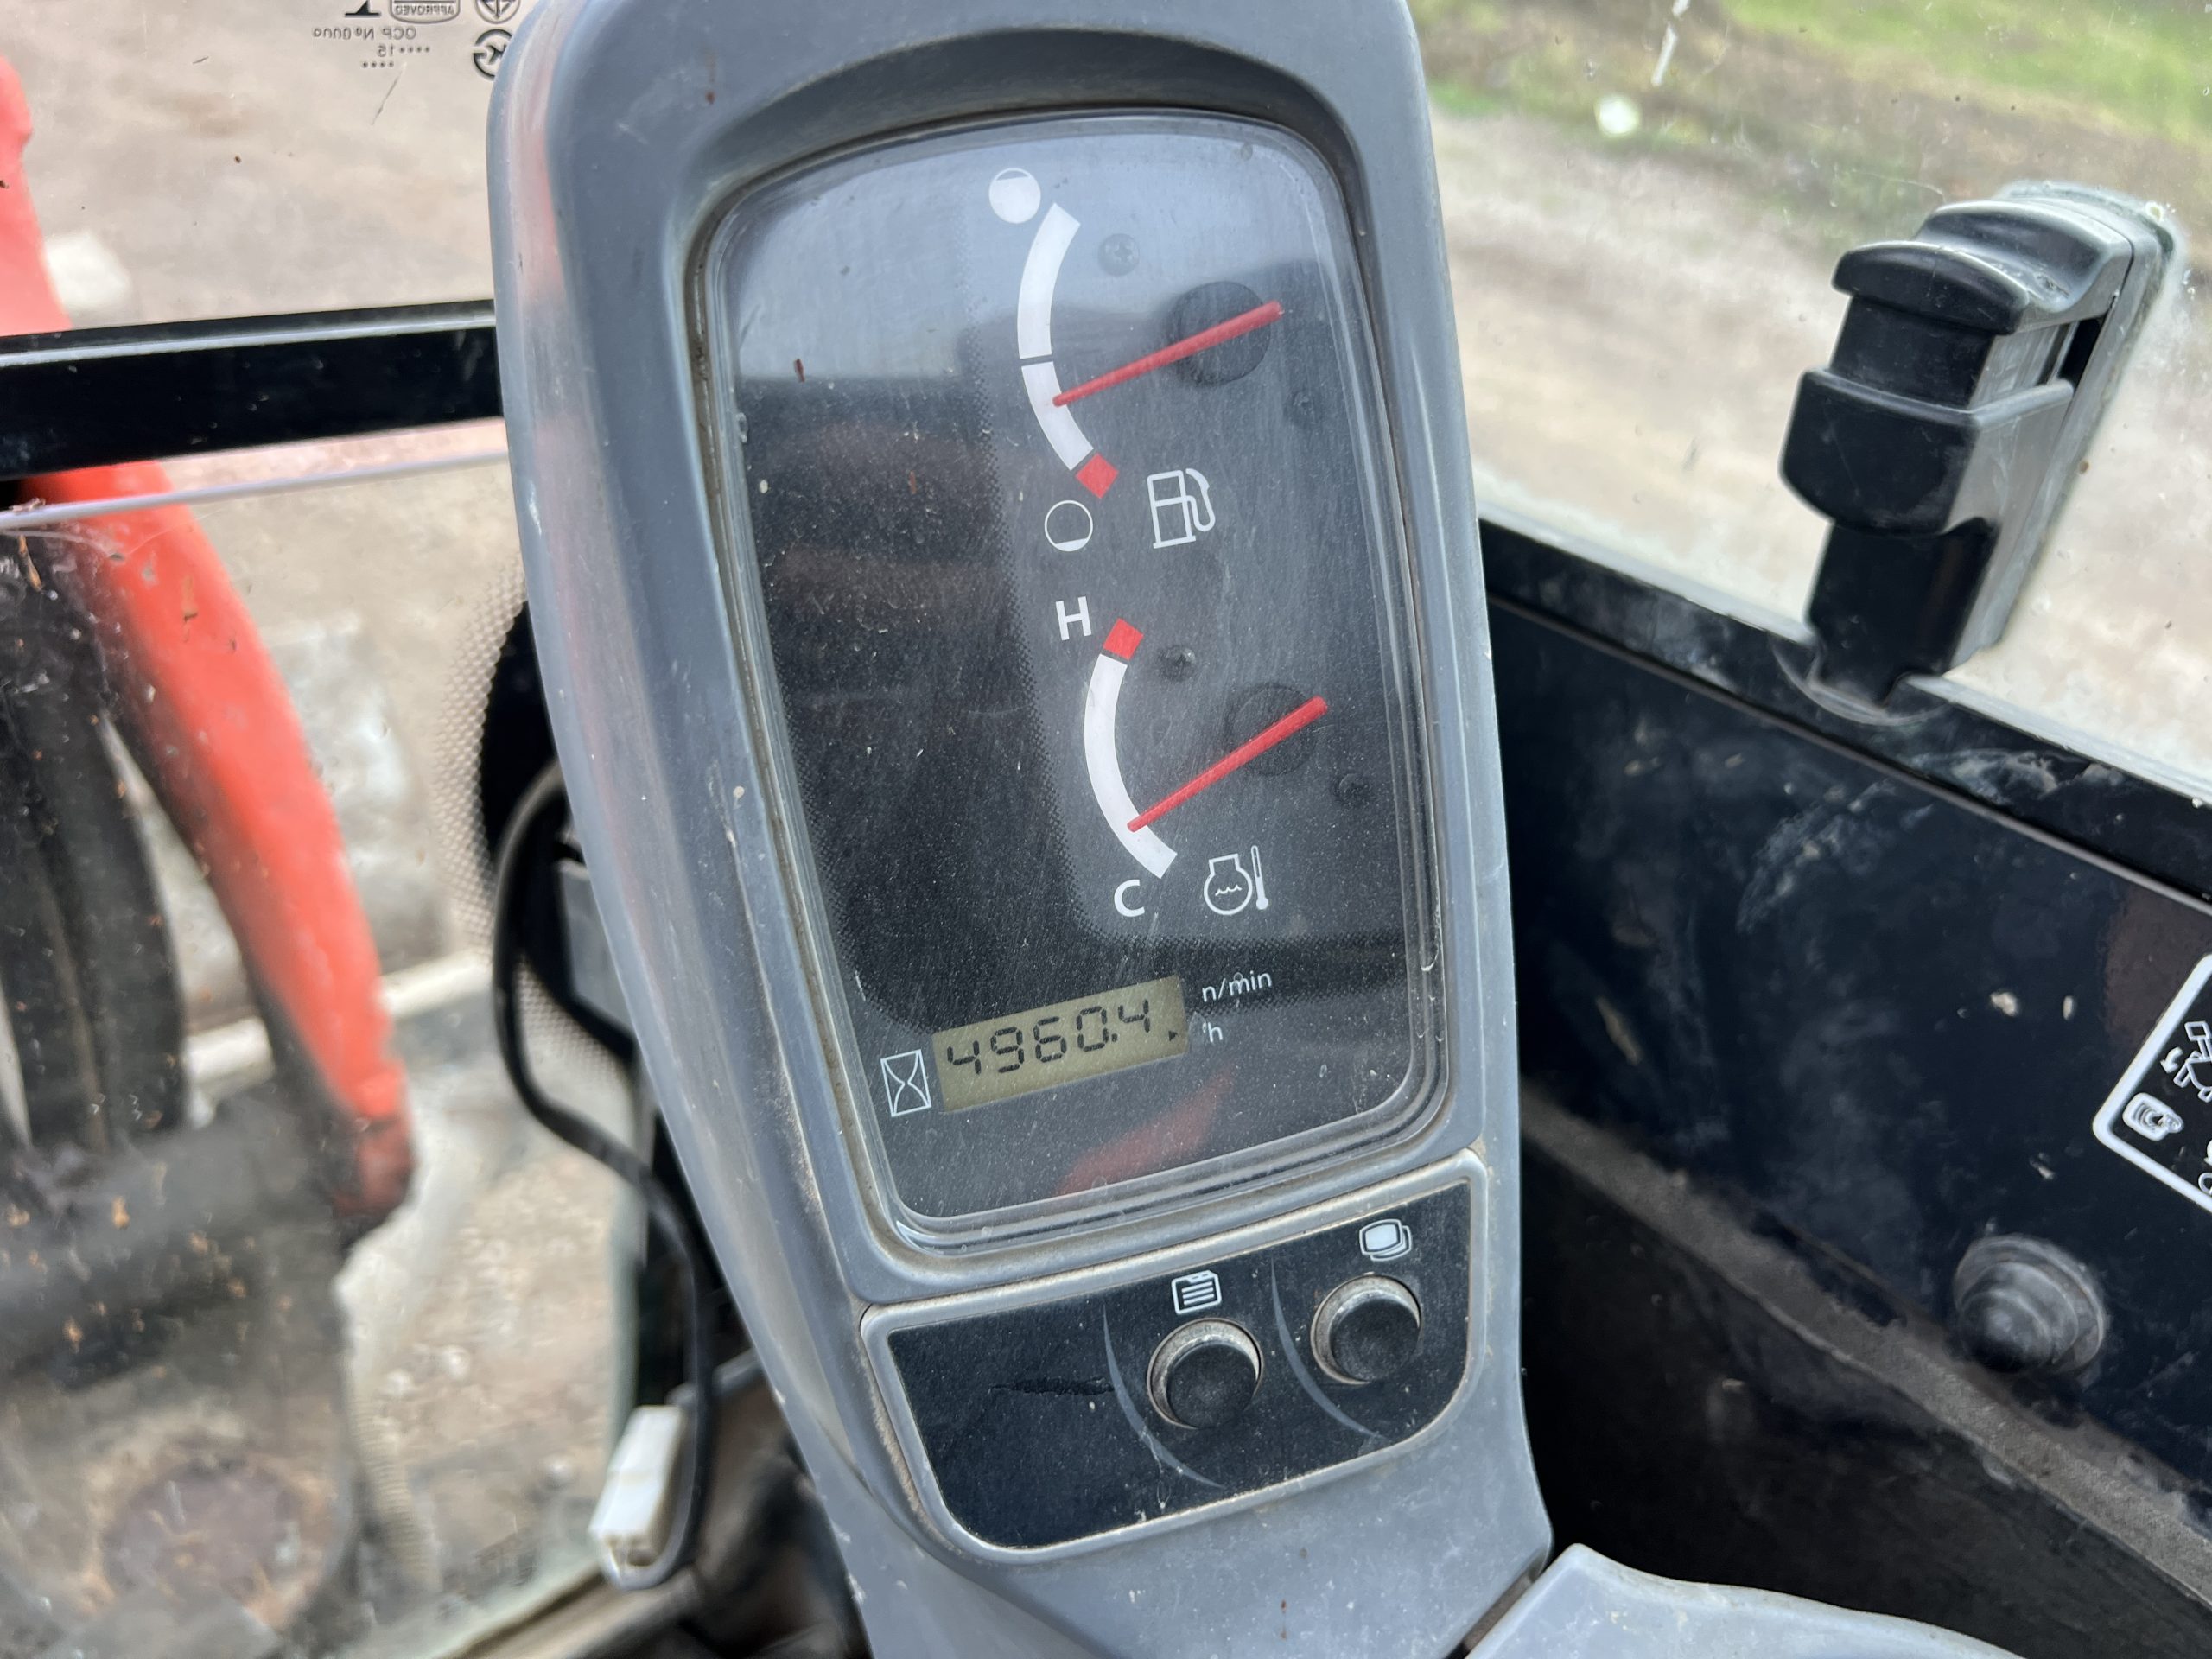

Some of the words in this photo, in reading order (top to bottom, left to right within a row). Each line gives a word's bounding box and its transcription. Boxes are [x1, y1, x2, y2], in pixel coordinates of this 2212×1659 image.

[1055, 596, 1091, 640] H
[1113, 879, 1145, 917] C
[1202, 970, 1273, 1002] n/min
[947, 999, 1150, 1074] 4960.4
[1207, 1022, 1223, 1043] h
